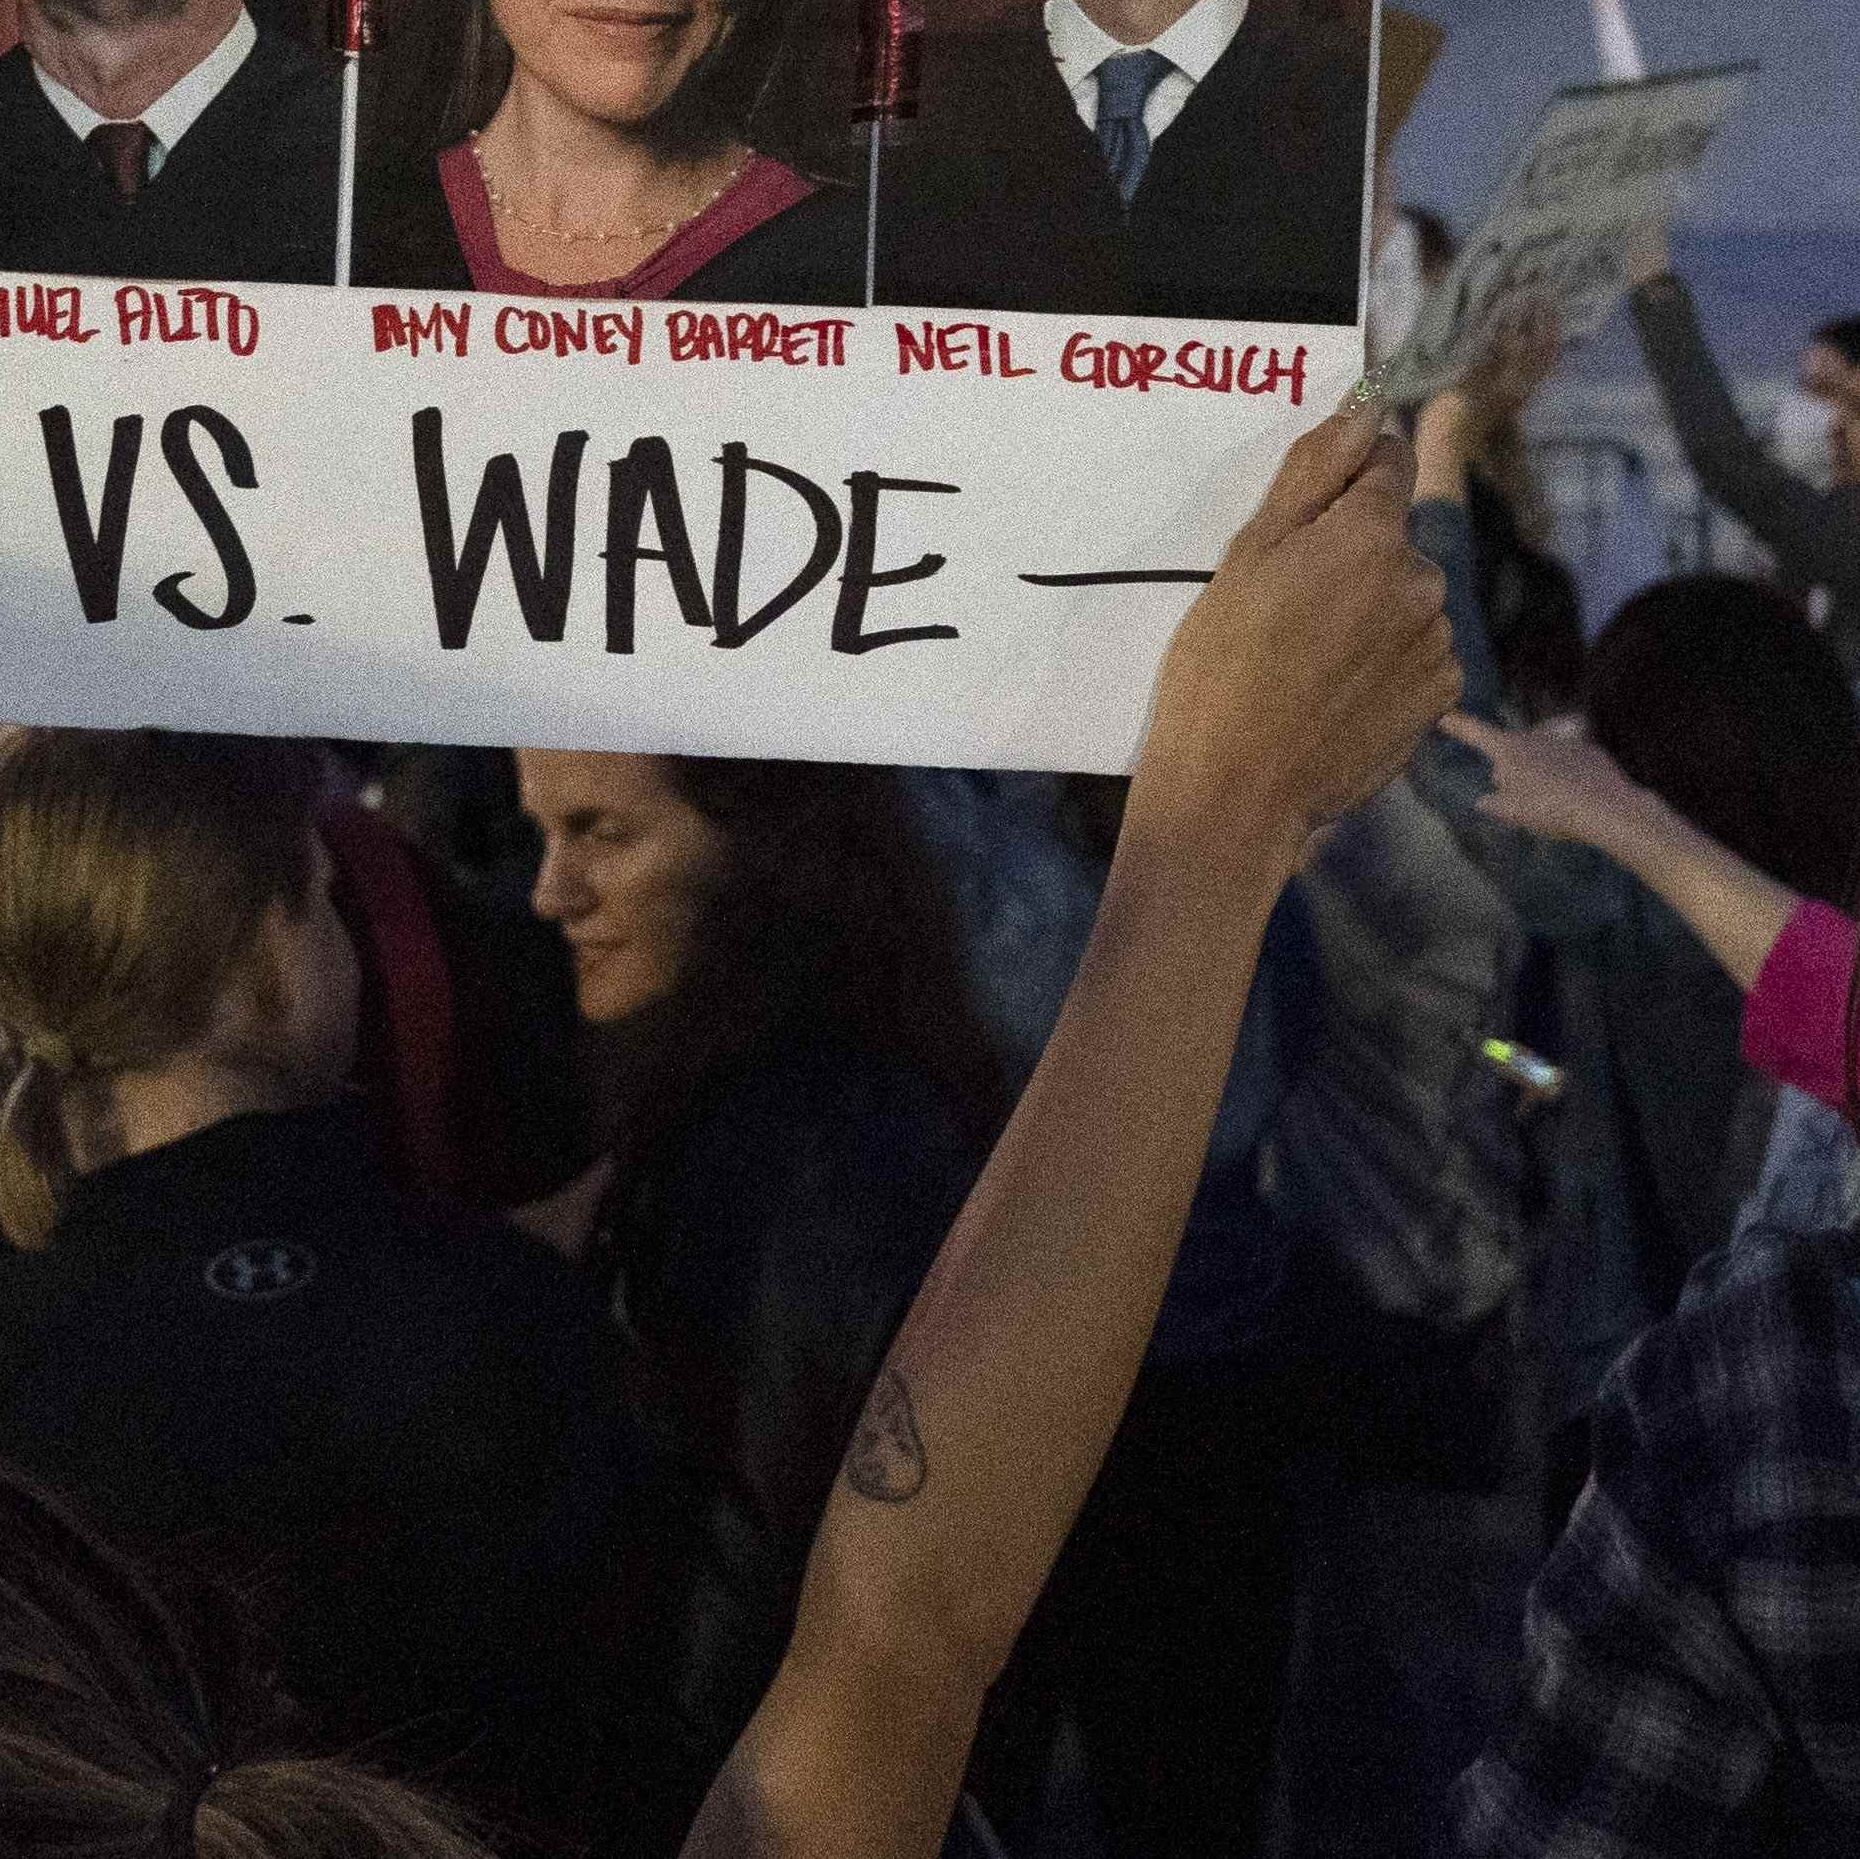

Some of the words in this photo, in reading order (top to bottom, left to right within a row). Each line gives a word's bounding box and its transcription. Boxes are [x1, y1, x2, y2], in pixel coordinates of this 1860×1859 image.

[114, 285, 259, 357] ALITO
[372, 303, 471, 358] AMY
[494, 307, 644, 365] CONEY
[667, 310, 850, 366] BARRETT
[895, 321, 1032, 378] NEIL
[1060, 332, 1307, 405] GORSUCH
[40, 406, 313, 630] VS.
[413, 408, 958, 654] WADE
